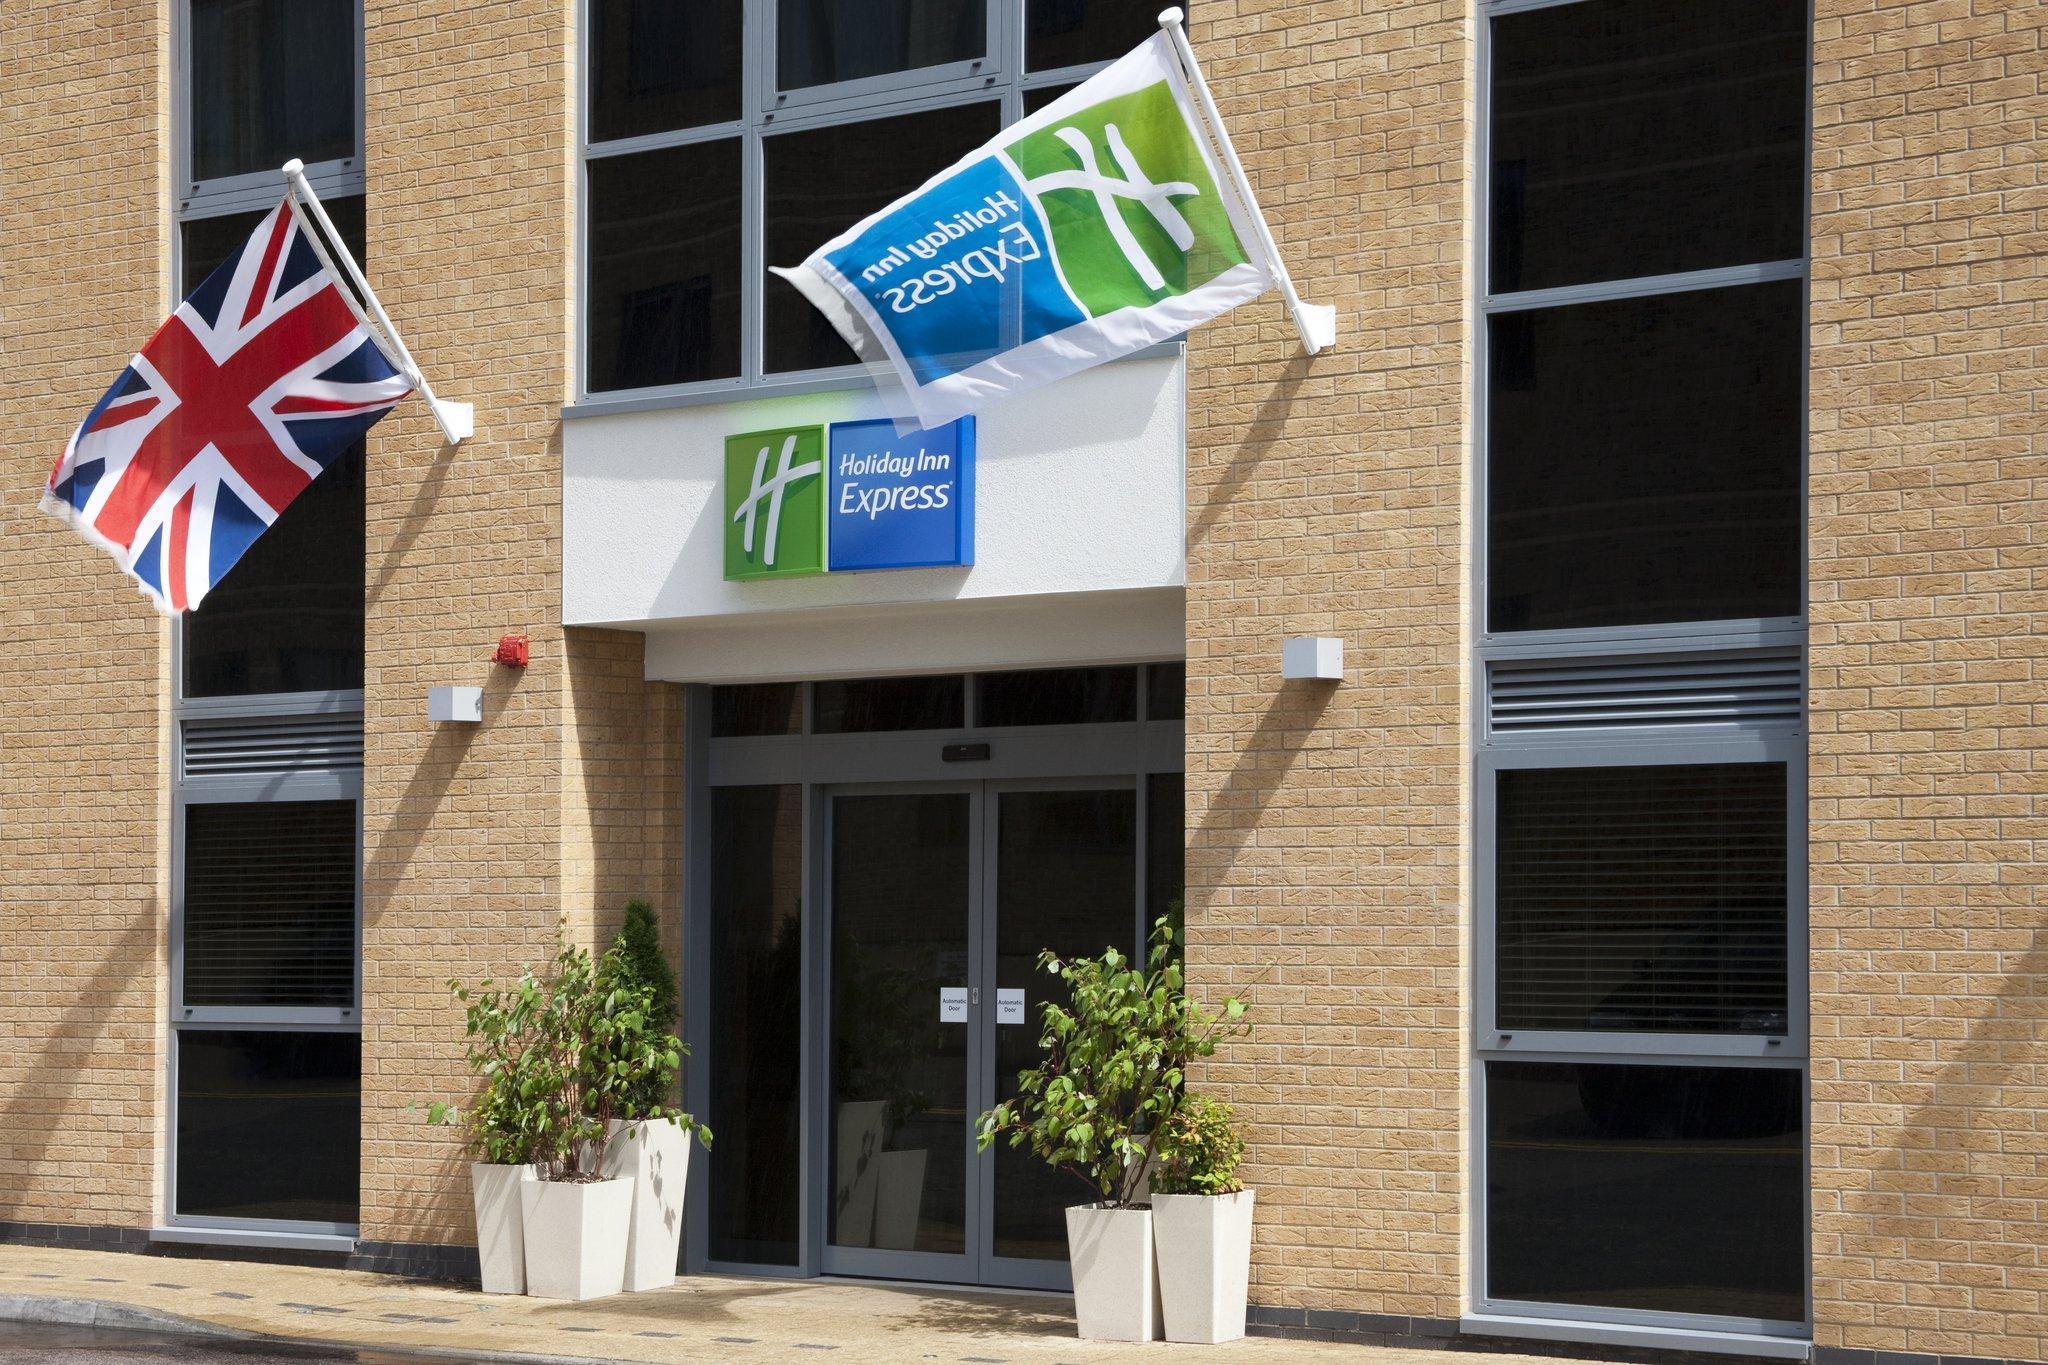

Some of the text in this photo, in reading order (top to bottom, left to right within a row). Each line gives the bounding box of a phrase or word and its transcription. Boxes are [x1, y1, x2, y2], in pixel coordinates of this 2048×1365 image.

[839, 448, 950, 478] Holiday Inn
[839, 482, 951, 521] Express
